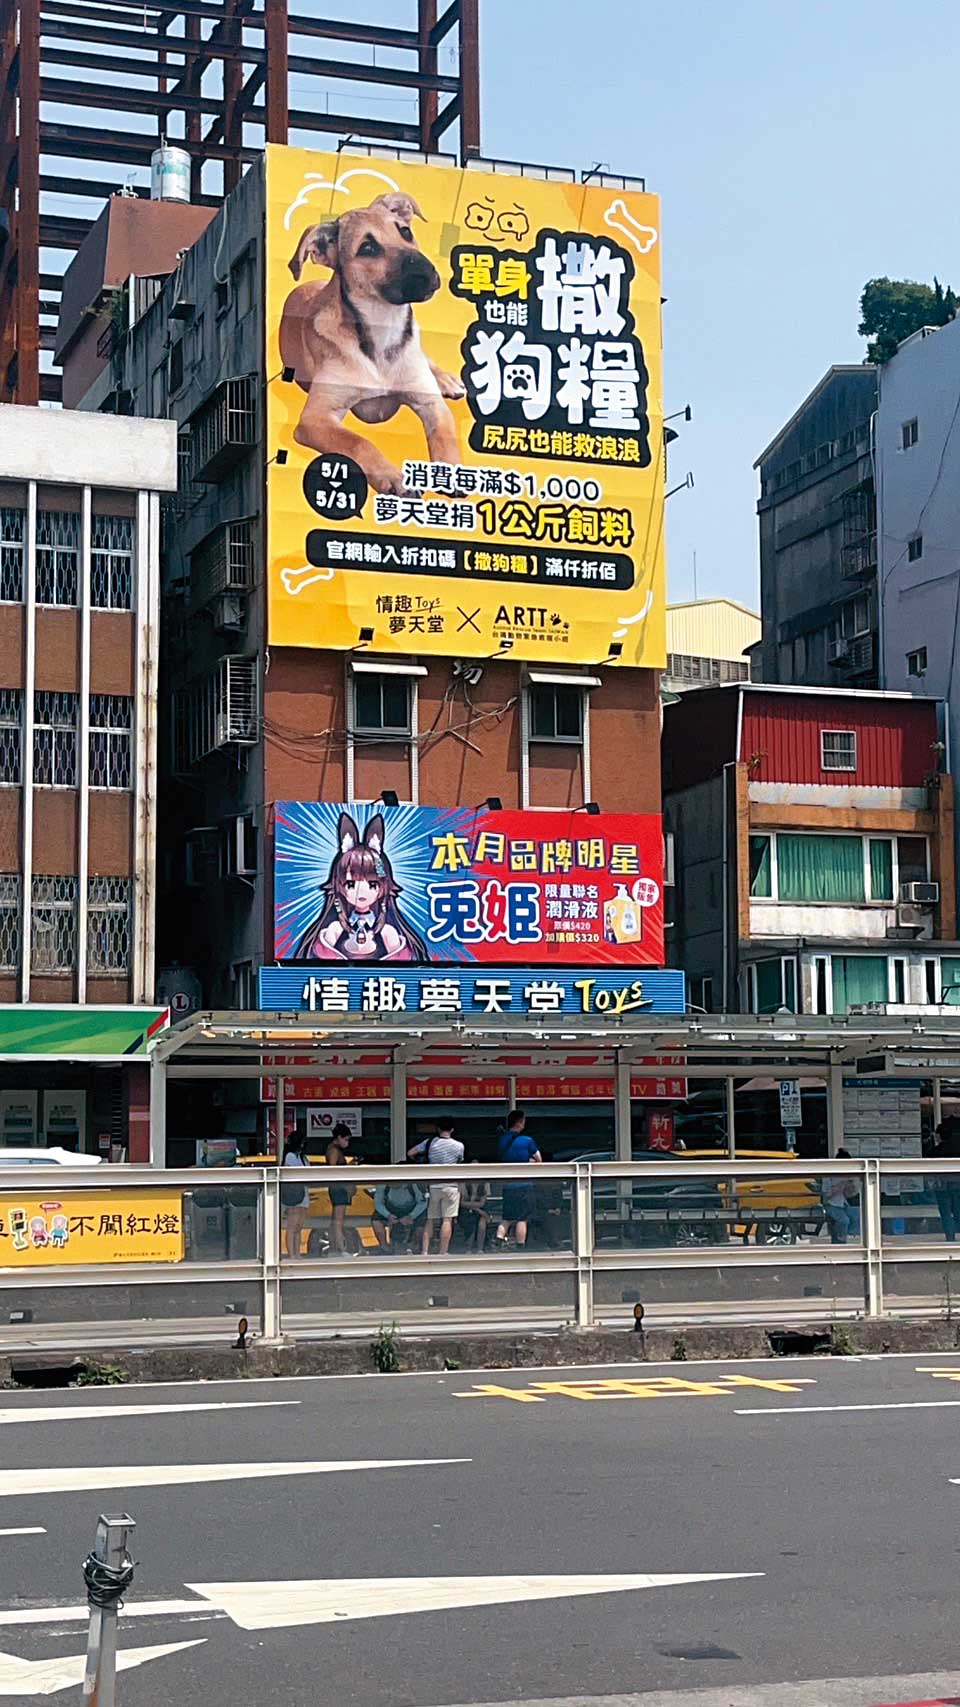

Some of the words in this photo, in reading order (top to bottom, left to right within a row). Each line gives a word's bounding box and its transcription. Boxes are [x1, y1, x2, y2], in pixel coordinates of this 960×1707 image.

[458, 253, 532, 300] 單身
[535, 238, 626, 336] 撒
[484, 301, 528, 326] 也能
[470, 331, 641, 431] 狗糧
[482, 424, 640, 462] 尻尻也能救浪浪
[321, 462, 349, 480] 5/1
[404, 462, 600, 502] 消費每滿$1,000
[315, 490, 357, 510] 5/31
[376, 595, 413, 613] 情趣
[415, 596, 442, 612] Toys
[494, 605, 548, 627] ARTT
[389, 615, 444, 634] 夢天堂
[430, 832, 640, 875] 本月品牌明星
[545, 884, 598, 898] 限量聯名
[546, 900, 598, 918] 潤滑液
[302, 976, 566, 1013] 情趣夢天堂
[575, 979, 653, 1013] Toys
[69, 1213, 180, 1237] 不闖紅燈
